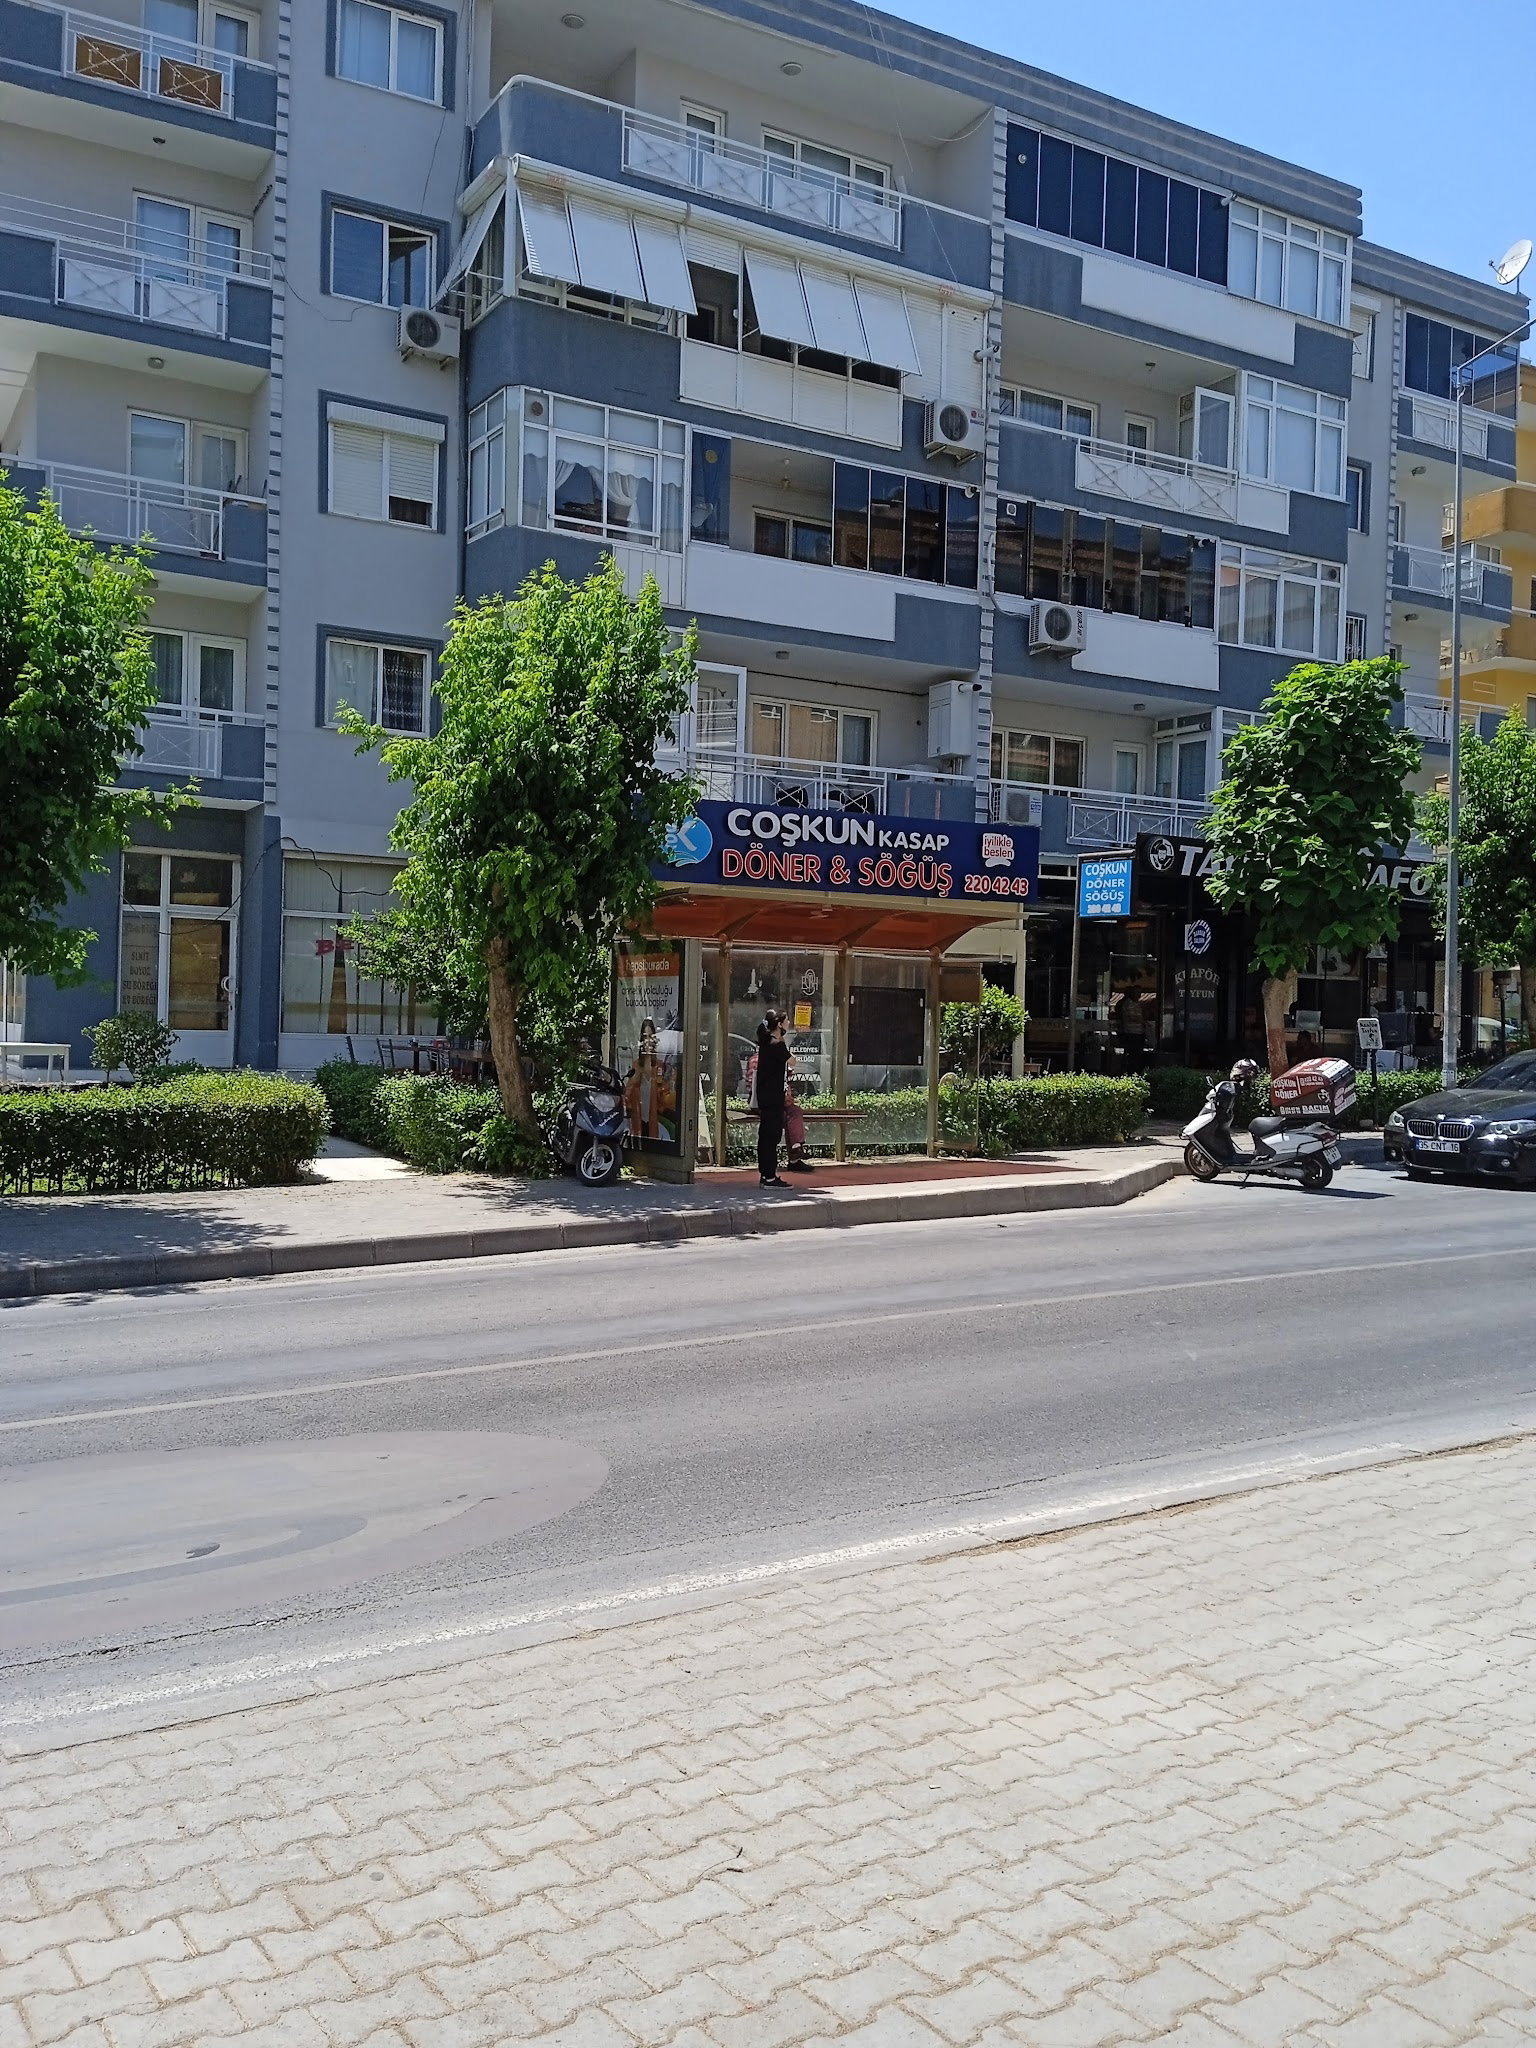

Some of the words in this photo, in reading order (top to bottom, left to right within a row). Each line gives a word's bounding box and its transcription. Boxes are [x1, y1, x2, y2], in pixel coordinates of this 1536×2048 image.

[727, 808, 874, 847] COŞKUN
[878, 829, 950, 851] KASAP
[984, 835, 1012, 847] iyilikle
[984, 846, 1013, 858] beslen
[722, 842, 821, 884] DÖNER
[829, 854, 851, 885] &
[858, 852, 953, 898] SÖĞÜŞ
[1085, 862, 1128, 877] COŞKUN
[964, 873, 991, 894] 220
[992, 875, 1010, 895] 42
[1010, 877, 1029, 897] 43
[1086, 877, 1125, 889] DÖNER
[1085, 889, 1125, 902] SÖĞÜŞ
[625, 958, 670, 974] hepsiburada
[1178, 989, 1216, 998] TYFUN
[648, 996, 668, 1009] başlar
[1274, 1088, 1299, 1100] DÖNER
[1419, 1140, 1429, 1150] 35
[1431, 1141, 1447, 1151] CNT
